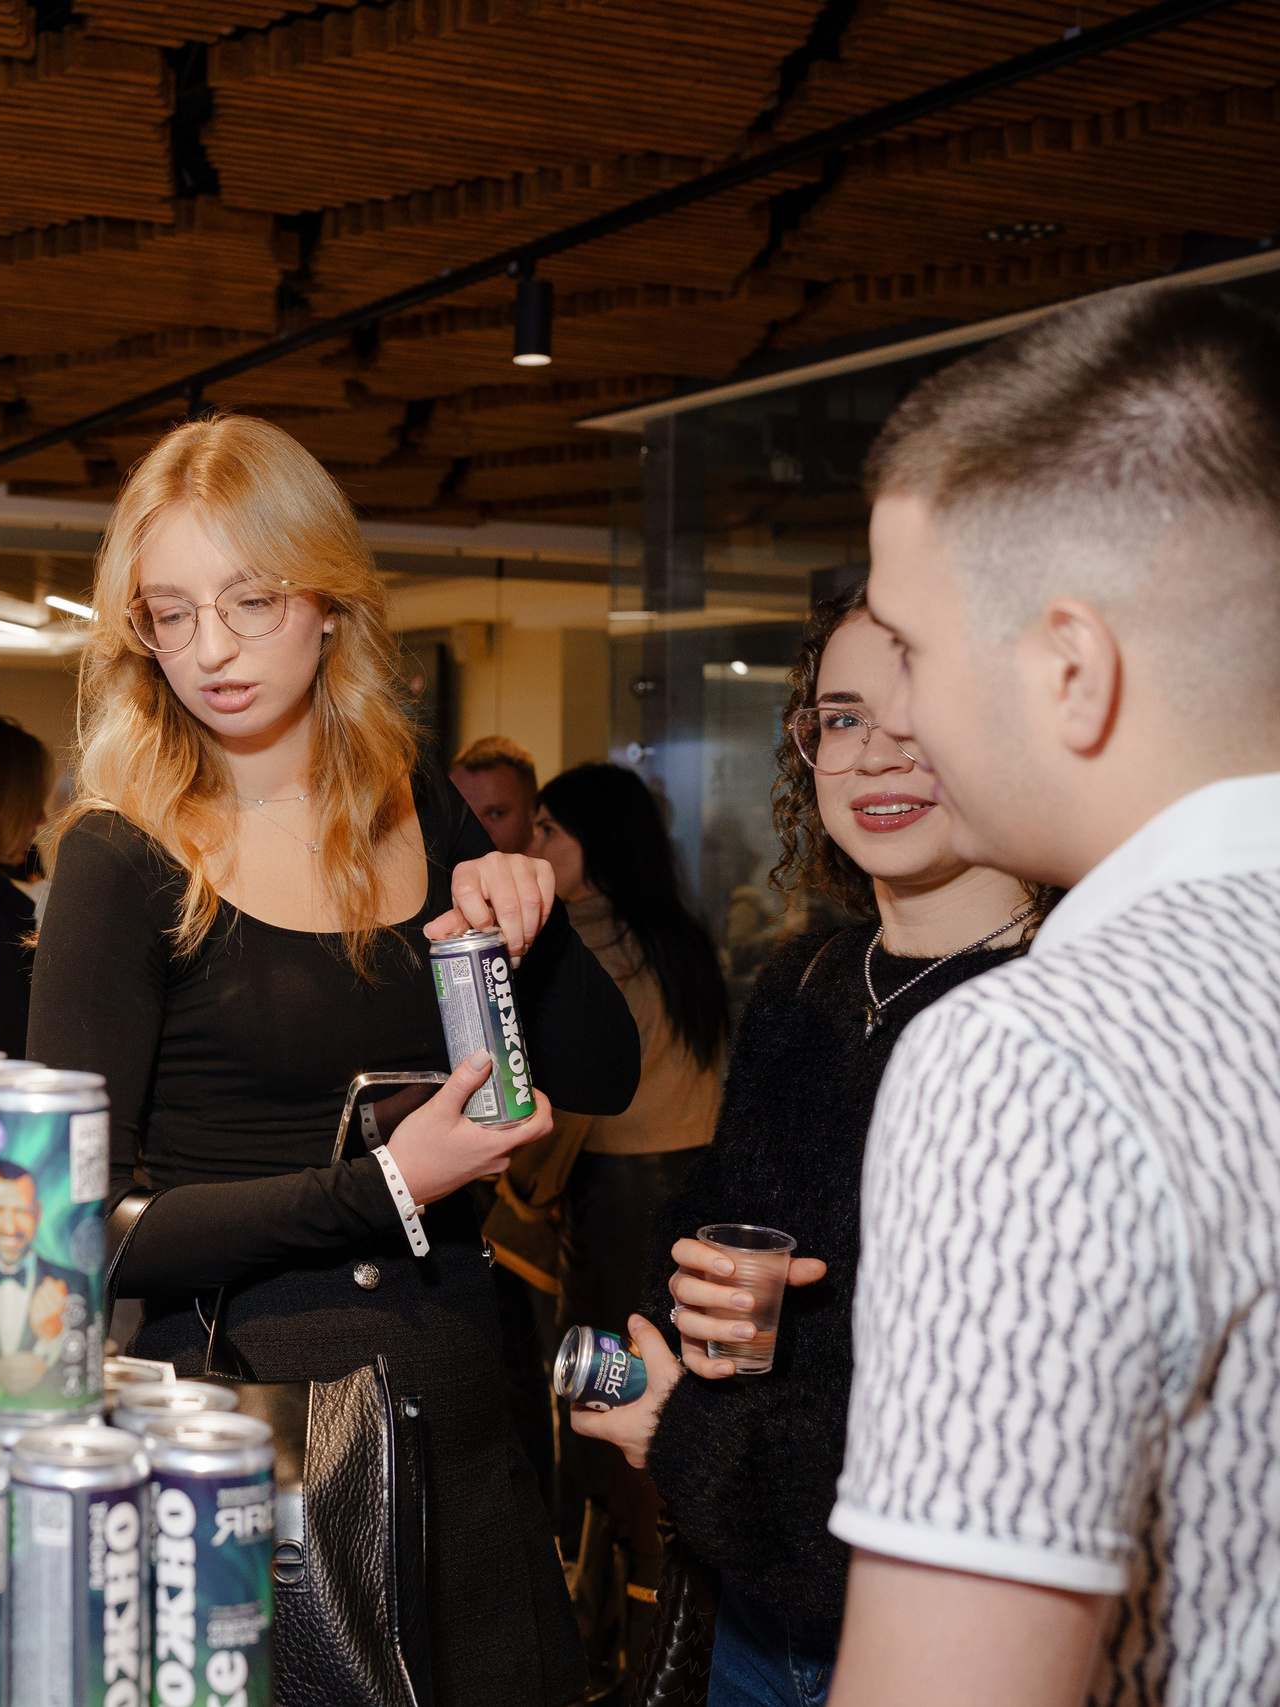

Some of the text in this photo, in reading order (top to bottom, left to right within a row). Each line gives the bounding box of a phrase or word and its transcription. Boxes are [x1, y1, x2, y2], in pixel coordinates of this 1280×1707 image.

[482, 958, 496, 1003] ЛИМОНАД
[491, 957, 531, 1106] МОЖНО
[103, 1501, 140, 1707] ОЖНО
[156, 1488, 197, 1707] ОЖНО
